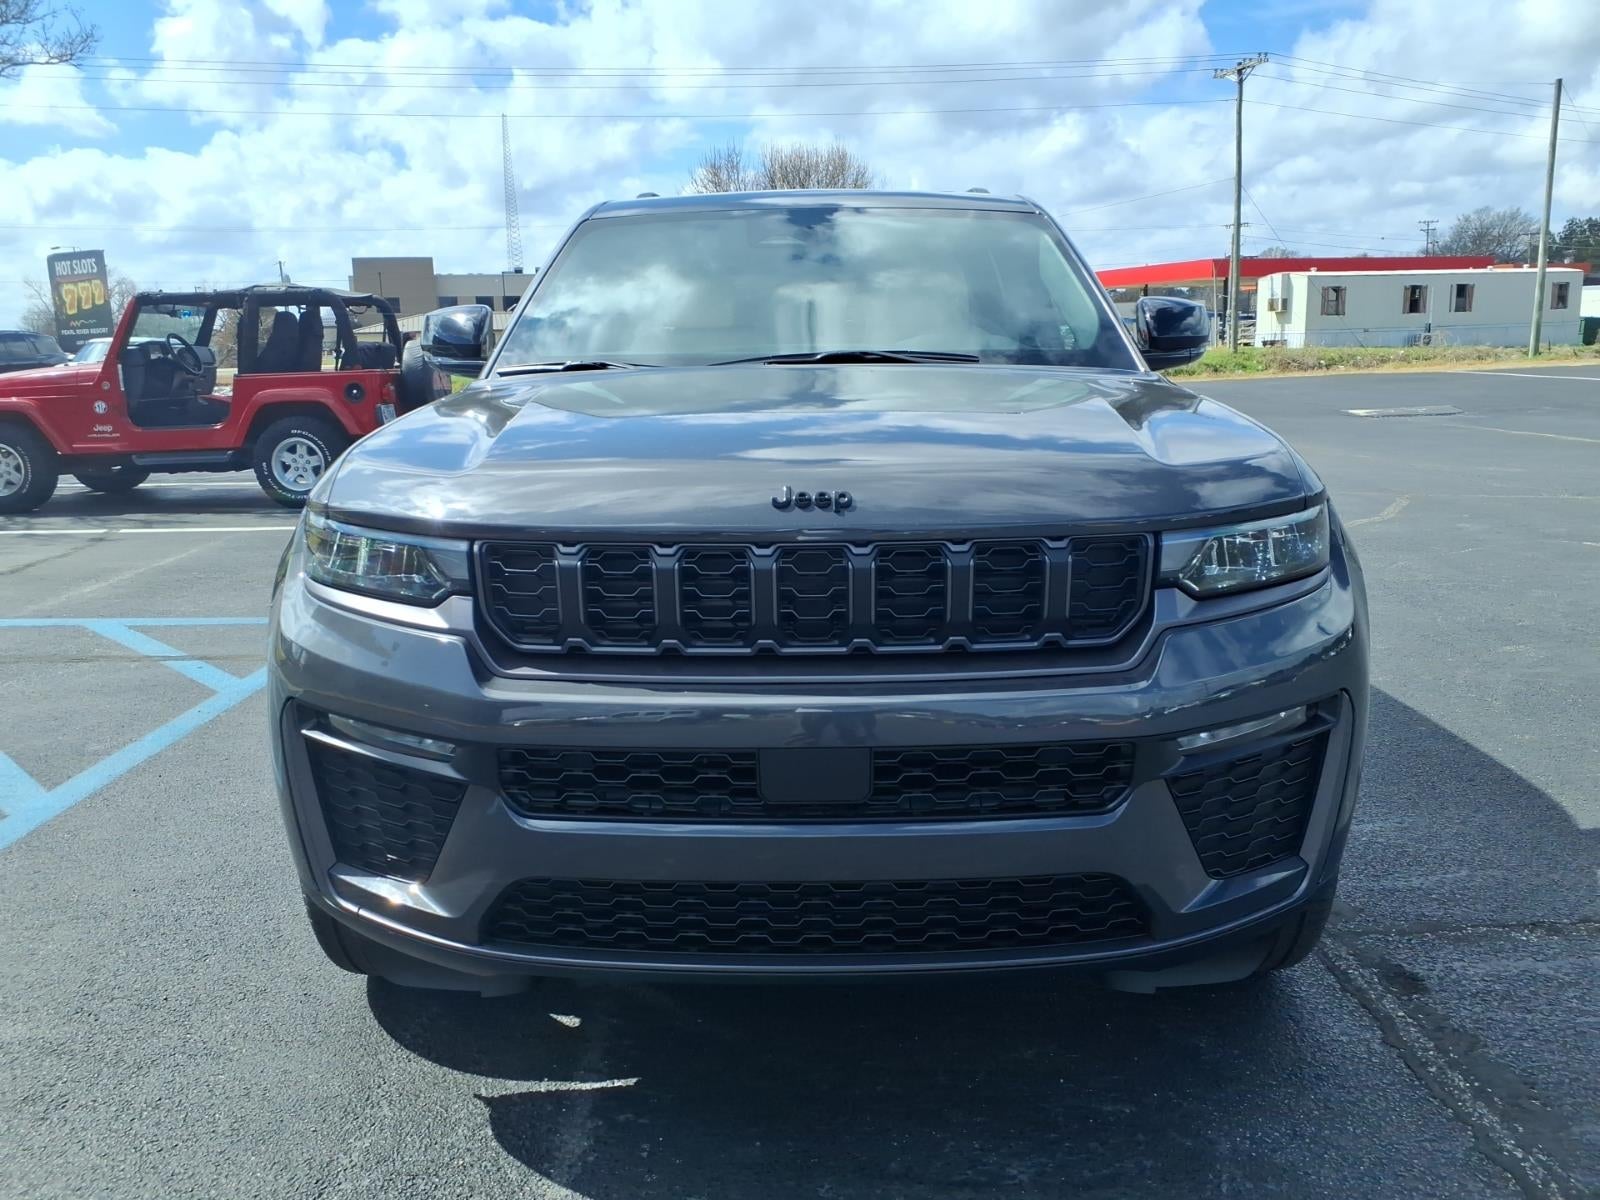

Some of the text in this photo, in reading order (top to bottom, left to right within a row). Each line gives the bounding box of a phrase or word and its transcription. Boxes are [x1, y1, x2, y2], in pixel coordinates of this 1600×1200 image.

[54, 258, 98, 277] HOT SLOTS
[93, 424, 113, 432] Jeep
[771, 485, 853, 513] Jeep
